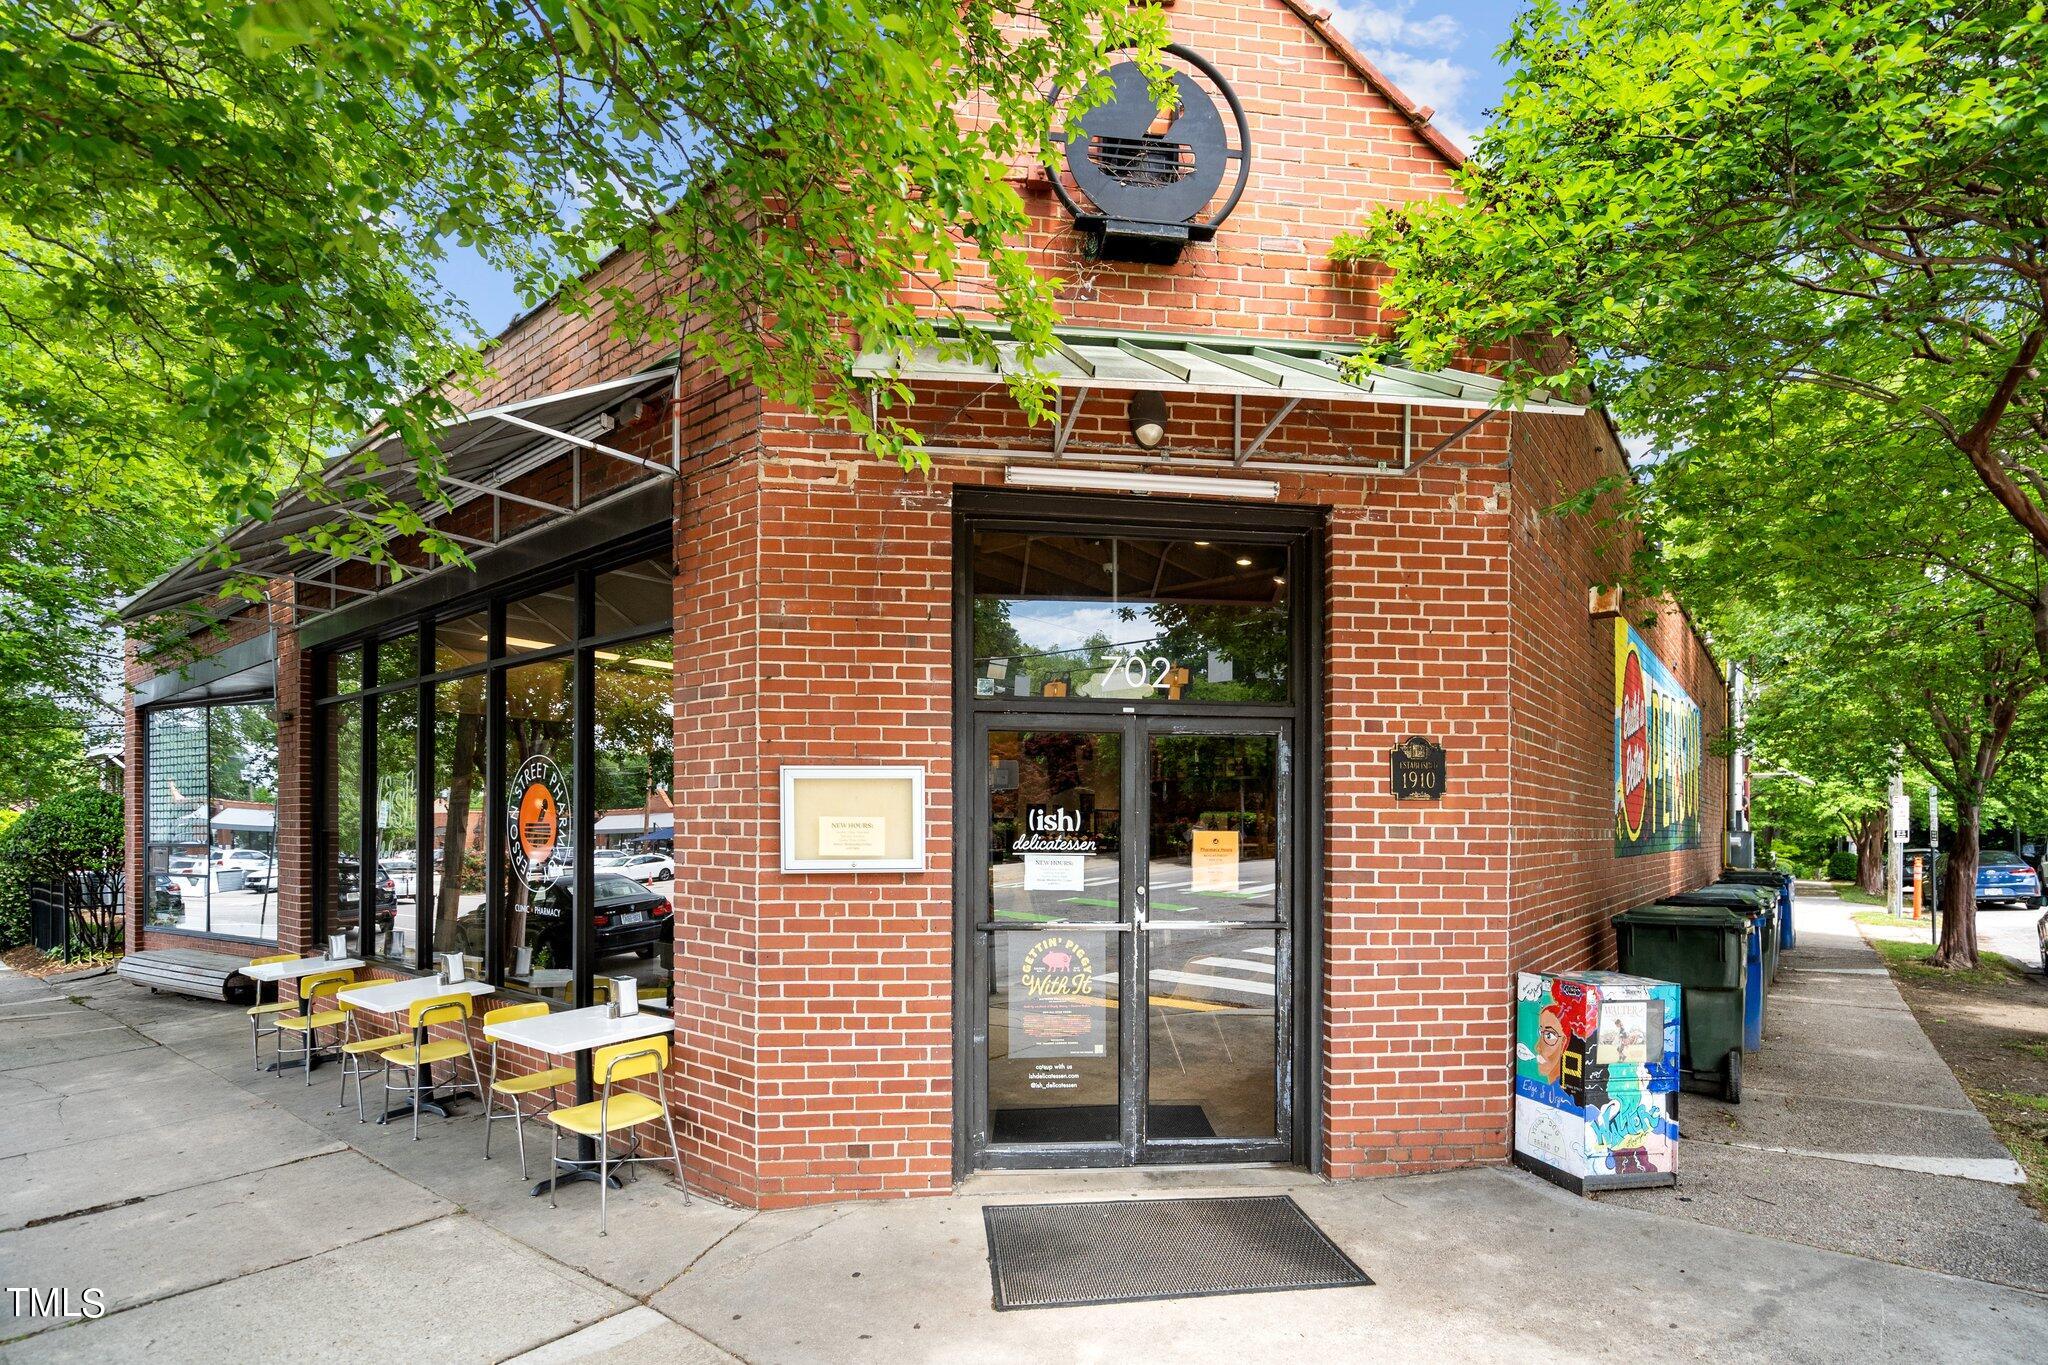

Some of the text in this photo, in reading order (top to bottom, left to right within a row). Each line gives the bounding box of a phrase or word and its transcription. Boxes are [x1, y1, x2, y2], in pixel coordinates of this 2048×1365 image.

[1101, 656, 1171, 688] 702
[1403, 771, 1436, 789] 1910
[508, 762, 568, 883] PERSON STREET PHARMACY
[1029, 807, 1082, 831] (ish)
[1012, 833, 1097, 851] delicatessen
[514, 903, 561, 918] CLINIC PHARMACY
[1022, 937, 1092, 973] GETTIN' PIGGY
[1021, 973, 1093, 996] With It
[1522, 1079, 1538, 1098] Edge
